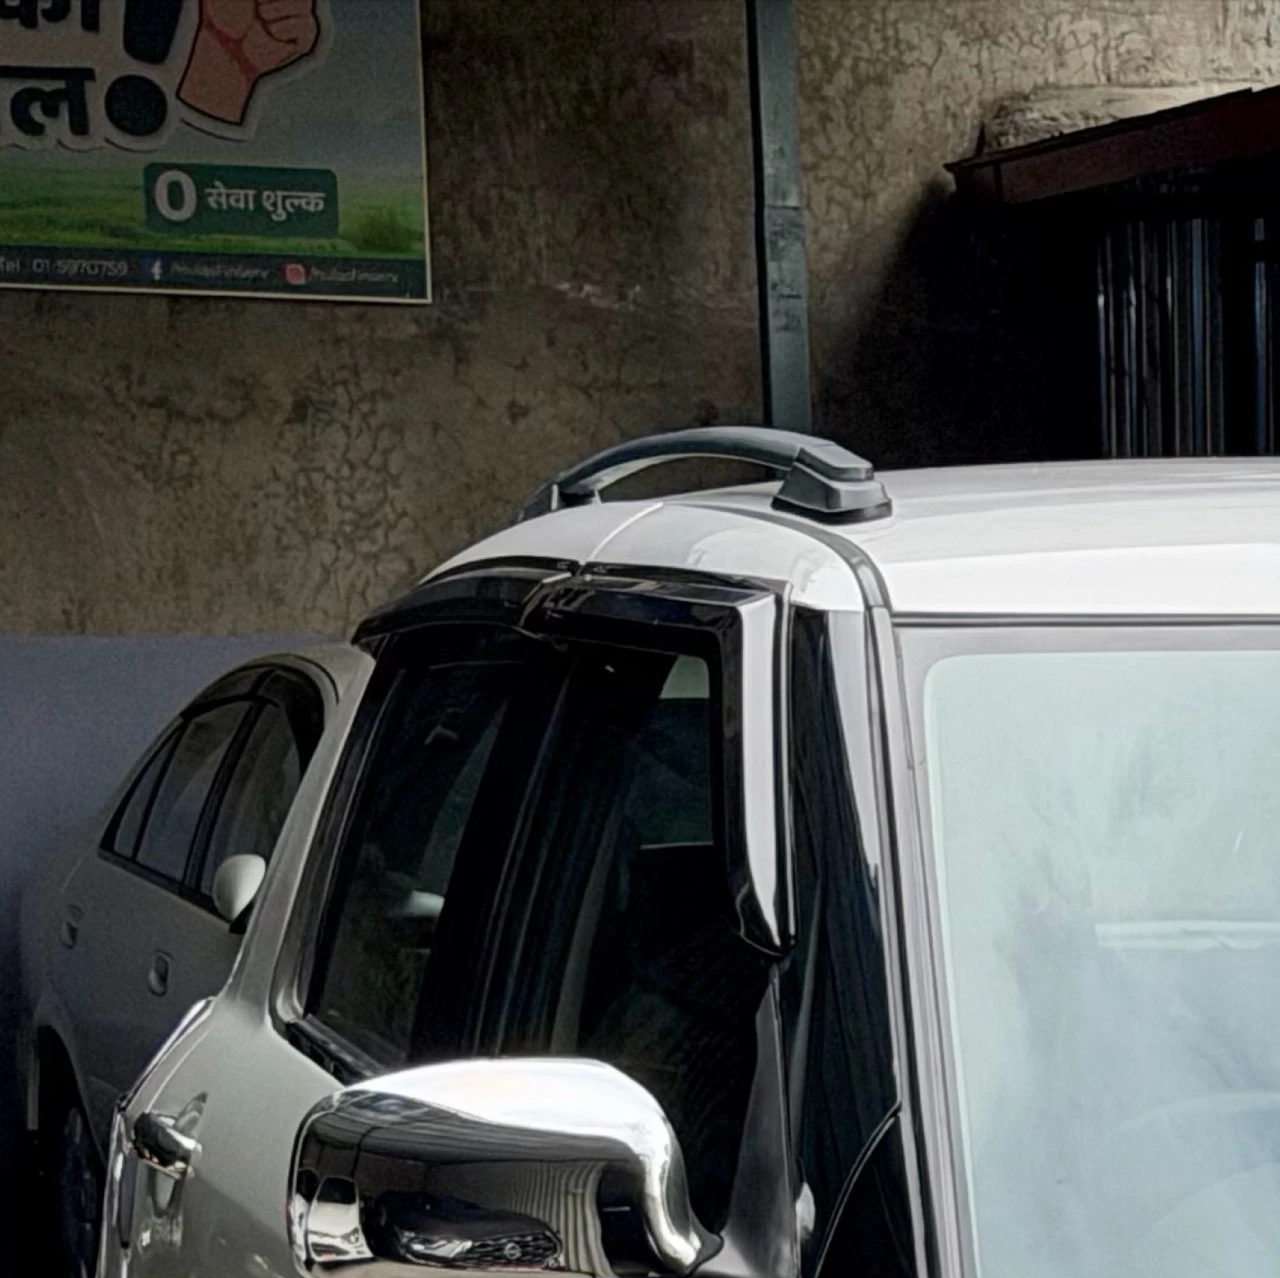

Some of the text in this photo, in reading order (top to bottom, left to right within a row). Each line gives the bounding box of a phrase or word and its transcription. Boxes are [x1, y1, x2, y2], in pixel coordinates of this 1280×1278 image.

[152, 169, 326, 222] 0 सेवा शुल्क
